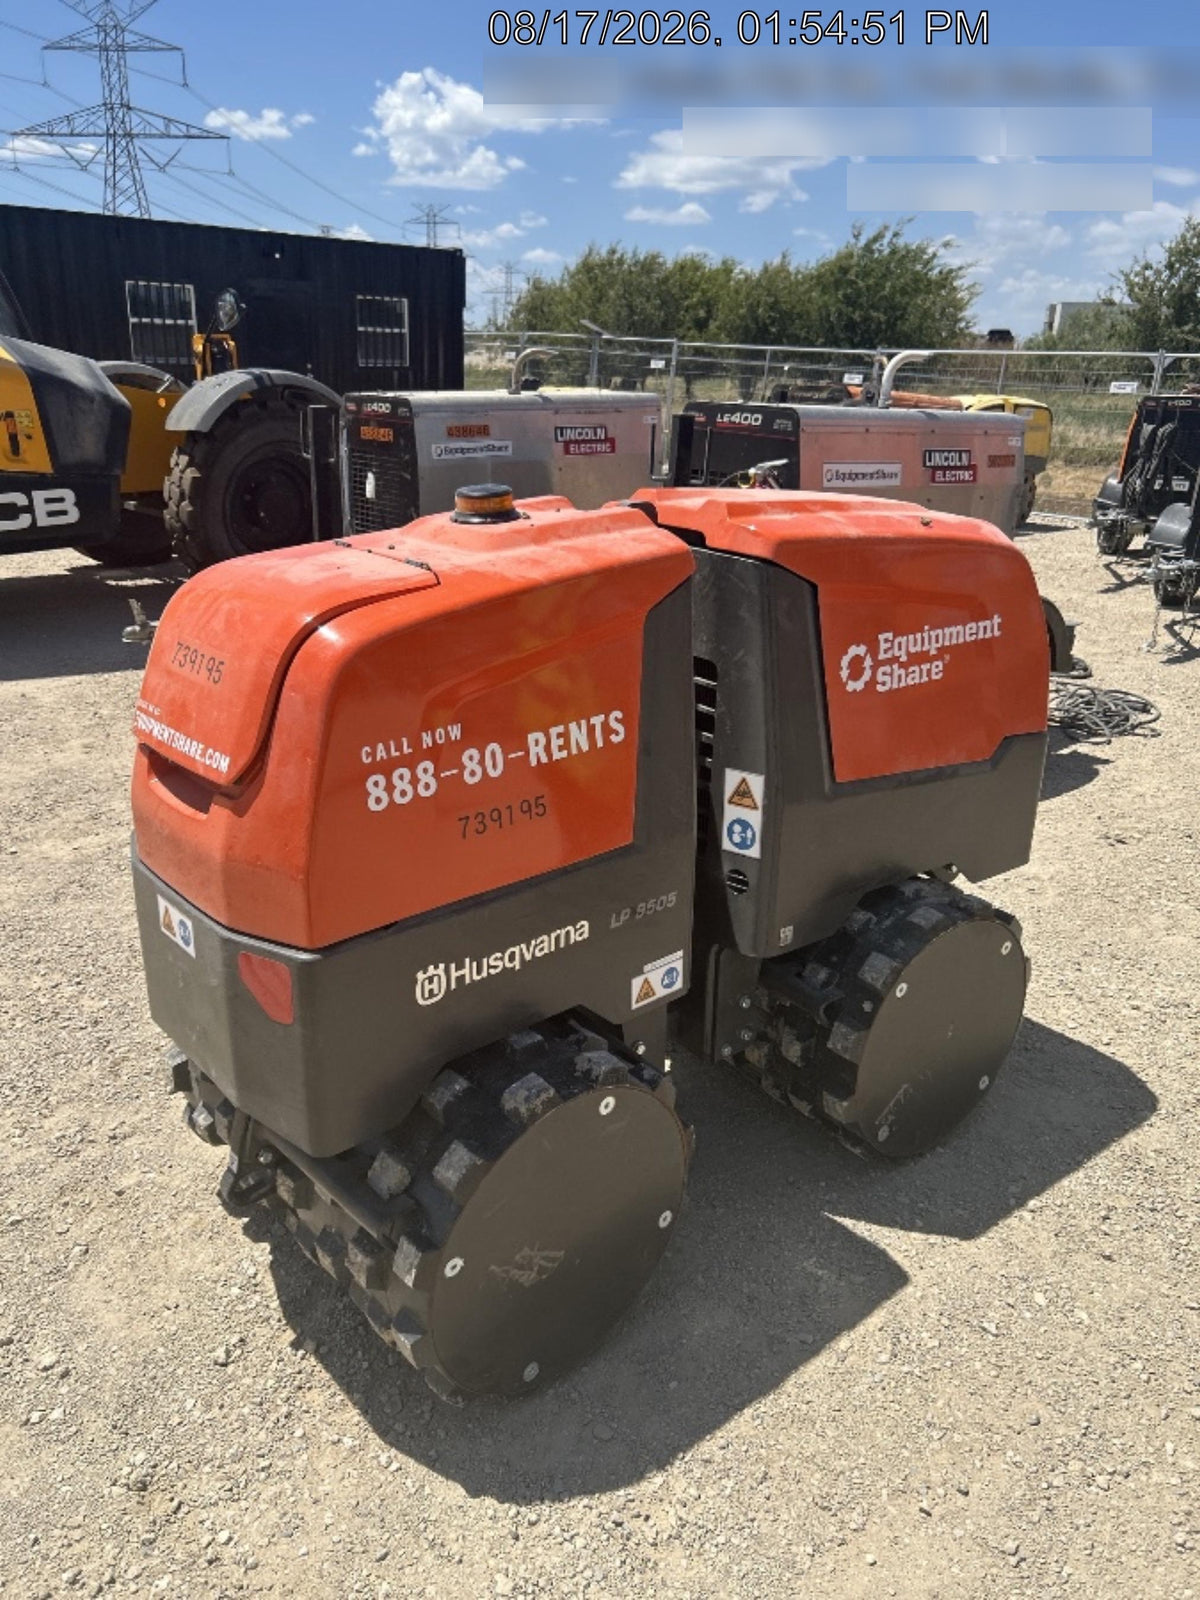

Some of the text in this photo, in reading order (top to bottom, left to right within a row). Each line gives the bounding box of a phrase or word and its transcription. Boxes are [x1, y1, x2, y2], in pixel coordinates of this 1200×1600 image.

[556, 427, 606, 441] LINCOLN
[716, 411, 763, 426] LE400
[569, 443, 612, 454] ELECTRIC
[925, 450, 970, 467] LINCOLN
[935, 470, 974, 482] ELECTRIC
[878, 614, 1002, 662] Equipment
[172, 641, 225, 685] 739195
[876, 660, 944, 692] Share
[361, 723, 462, 763] CALL NOW
[366, 710, 625, 812] 888-80-RENTS
[457, 795, 547, 839] 739195
[610, 907, 631, 929] LP
[450, 920, 589, 991] Husqvarna
